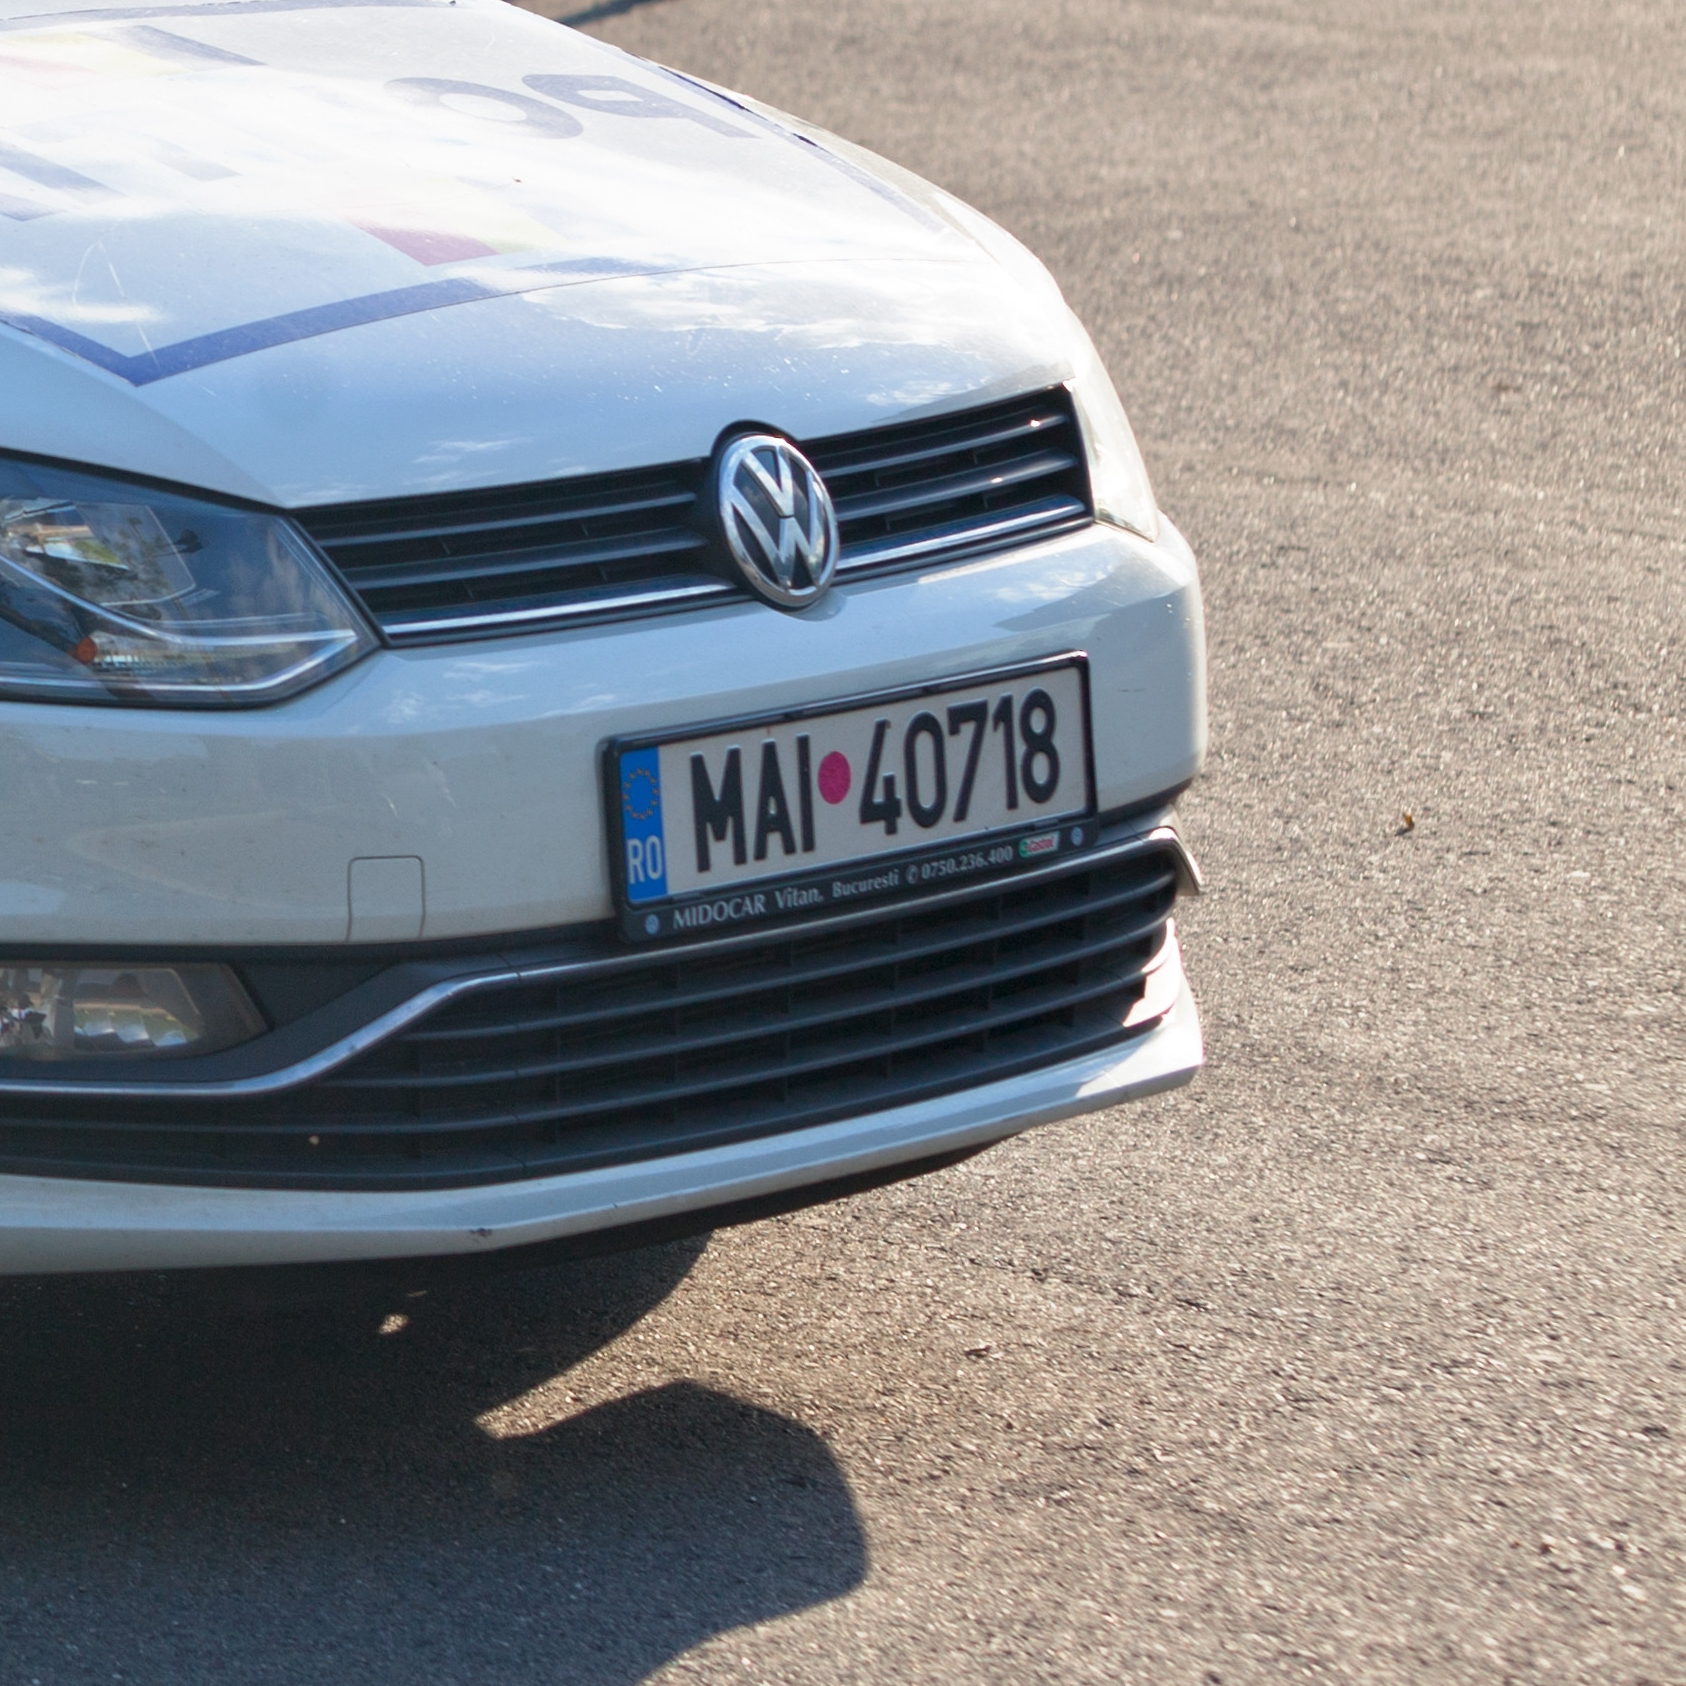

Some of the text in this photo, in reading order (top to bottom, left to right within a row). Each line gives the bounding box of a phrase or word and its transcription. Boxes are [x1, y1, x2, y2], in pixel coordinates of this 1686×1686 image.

[689, 686, 1062, 874] MAI 40718
[627, 834, 664, 886] RO
[672, 893, 767, 930] MIDOCAR
